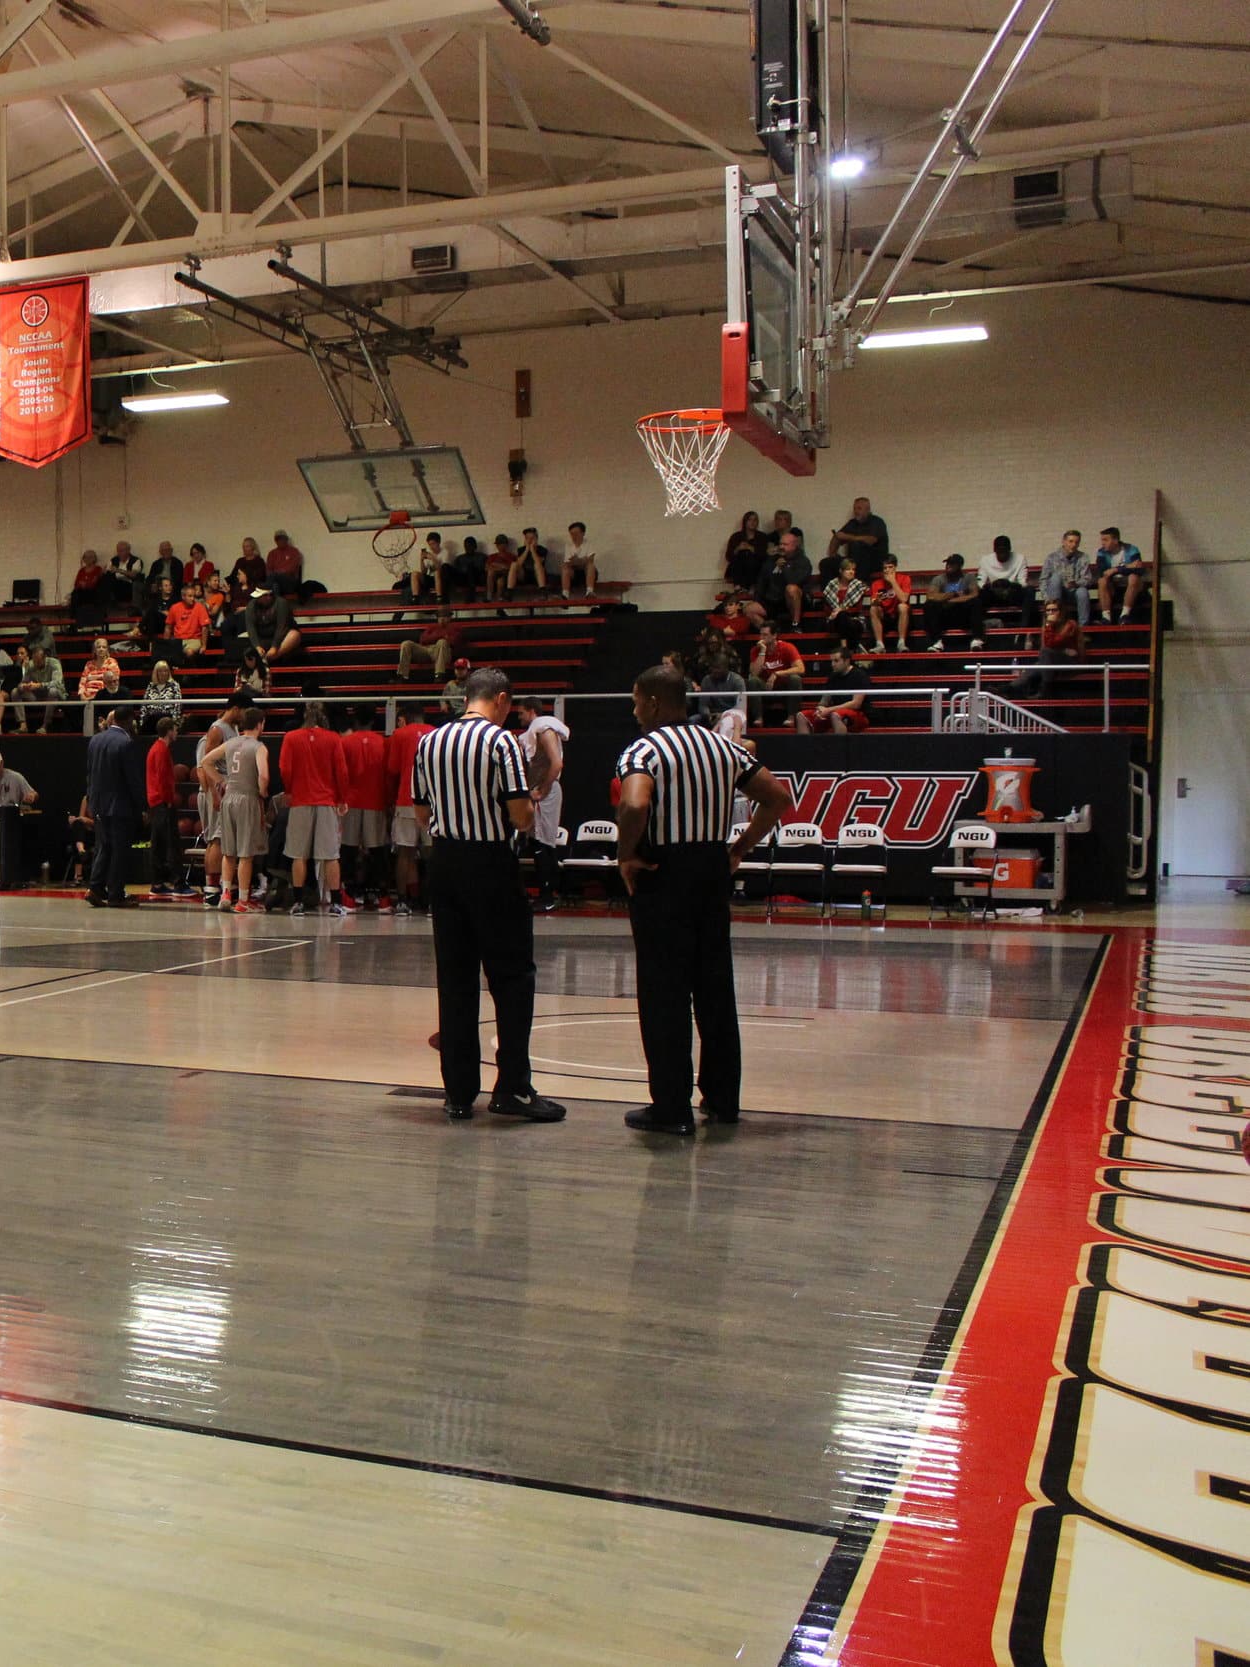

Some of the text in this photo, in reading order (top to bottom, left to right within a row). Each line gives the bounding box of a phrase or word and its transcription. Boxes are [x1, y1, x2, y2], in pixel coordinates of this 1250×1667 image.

[18, 332, 53, 343] NCCAA
[8, 341, 65, 355] Tournament
[23, 358, 49, 367] South
[21, 368, 52, 379] Region
[12, 376, 61, 388] Champions
[18, 386, 55, 397] 2003-04
[19, 396, 55, 406] 2005-06
[19, 406, 55, 416] 2010-11
[232, 751, 240, 773] 5
[750, 771, 980, 849] NGU
[583, 825, 613, 835] NGU
[785, 828, 816, 838] NGU
[845, 828, 878, 838] NGU
[957, 832, 990, 841] NGU
[993, 862, 1010, 882] G
